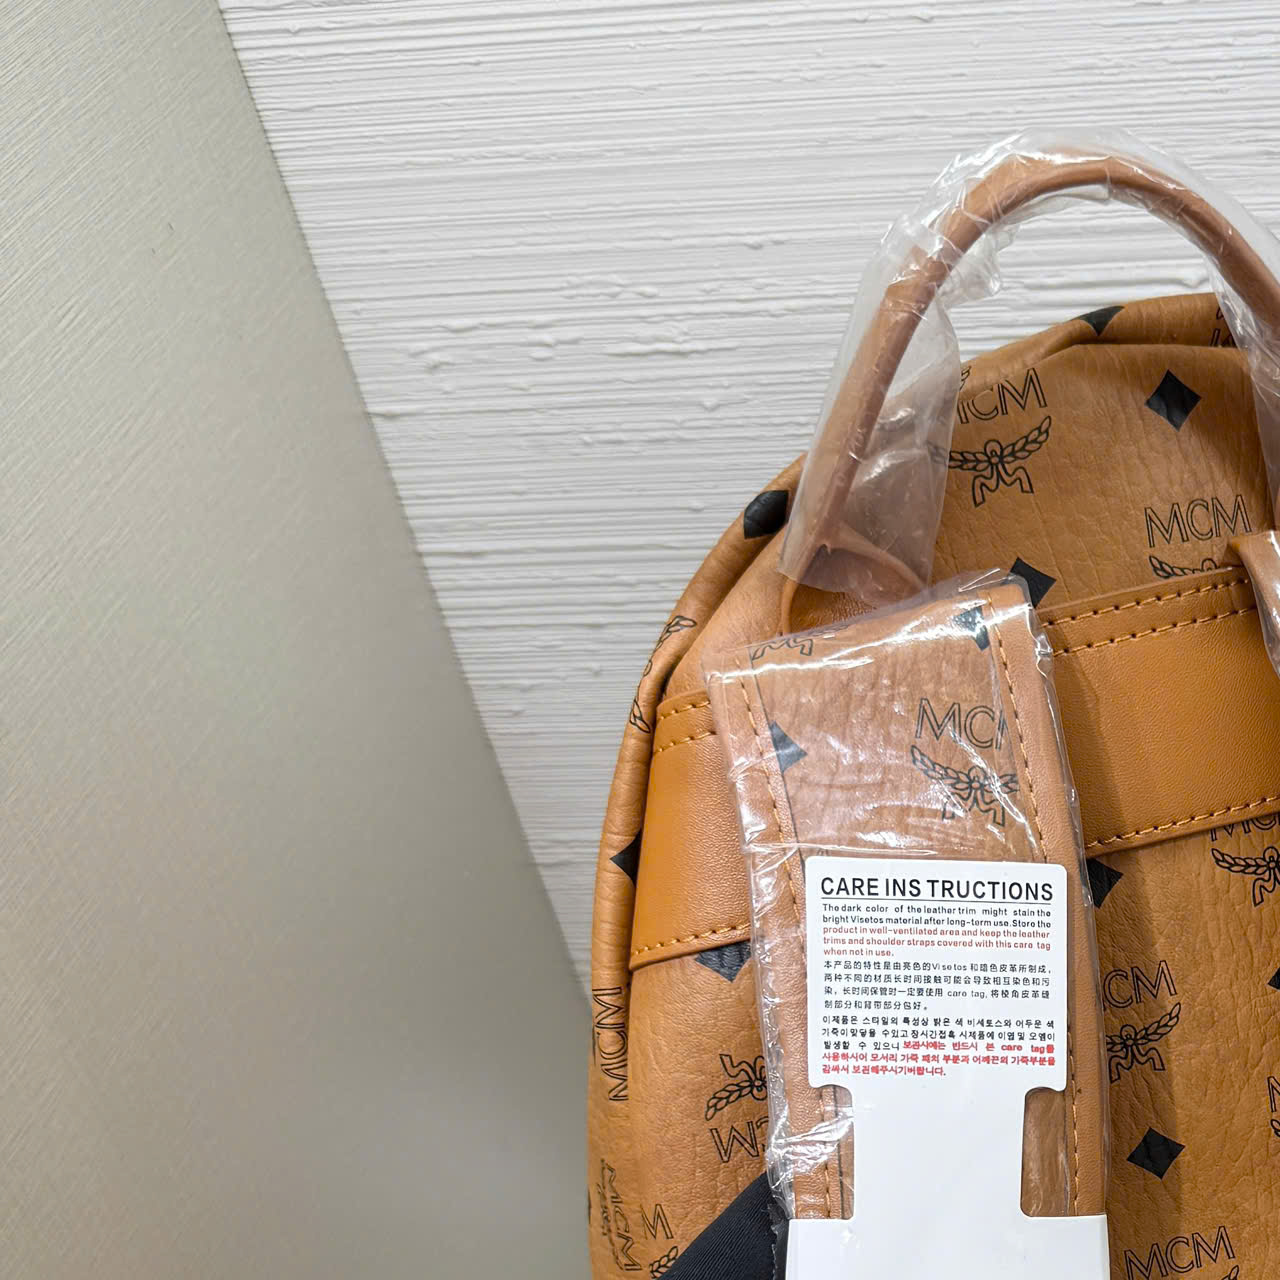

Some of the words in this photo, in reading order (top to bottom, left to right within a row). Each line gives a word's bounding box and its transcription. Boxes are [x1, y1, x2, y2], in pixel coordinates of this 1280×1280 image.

[1144, 494, 1253, 549] MCM
[822, 903, 840, 912] The
[841, 903, 862, 912] dark
[865, 904, 889, 913] color
[894, 904, 904, 913] of
[907, 905, 922, 914] the
[923, 905, 956, 914] leather
[958, 906, 977, 915] trim
[982, 907, 1008, 917] might
[1013, 908, 1035, 917] stain
[1037, 909, 1051, 917] the
[822, 914, 849, 925] bright
[850, 915, 884, 924] Visetos
[885, 916, 922, 925] material
[923, 916, 945, 925] after
[1037, 919, 1051, 929] the
[823, 926, 858, 934] product
[979, 929, 1001, 939] keep
[1003, 929, 1017, 938] the
[1018, 930, 1050, 939] leather
[823, 936, 846, 945] trims
[848, 937, 864, 945] and
[866, 937, 905, 946] shoulder
[907, 938, 935, 948] straps
[937, 939, 973, 947] covered
[975, 939, 994, 948] with
[995, 940, 1012, 949] this
[1036, 941, 1051, 951] tag
[823, 947, 847, 955] when
[849, 948, 864, 956] not
[1100, 960, 1178, 1012] CM
[1000, 1044, 1023, 1052] care
